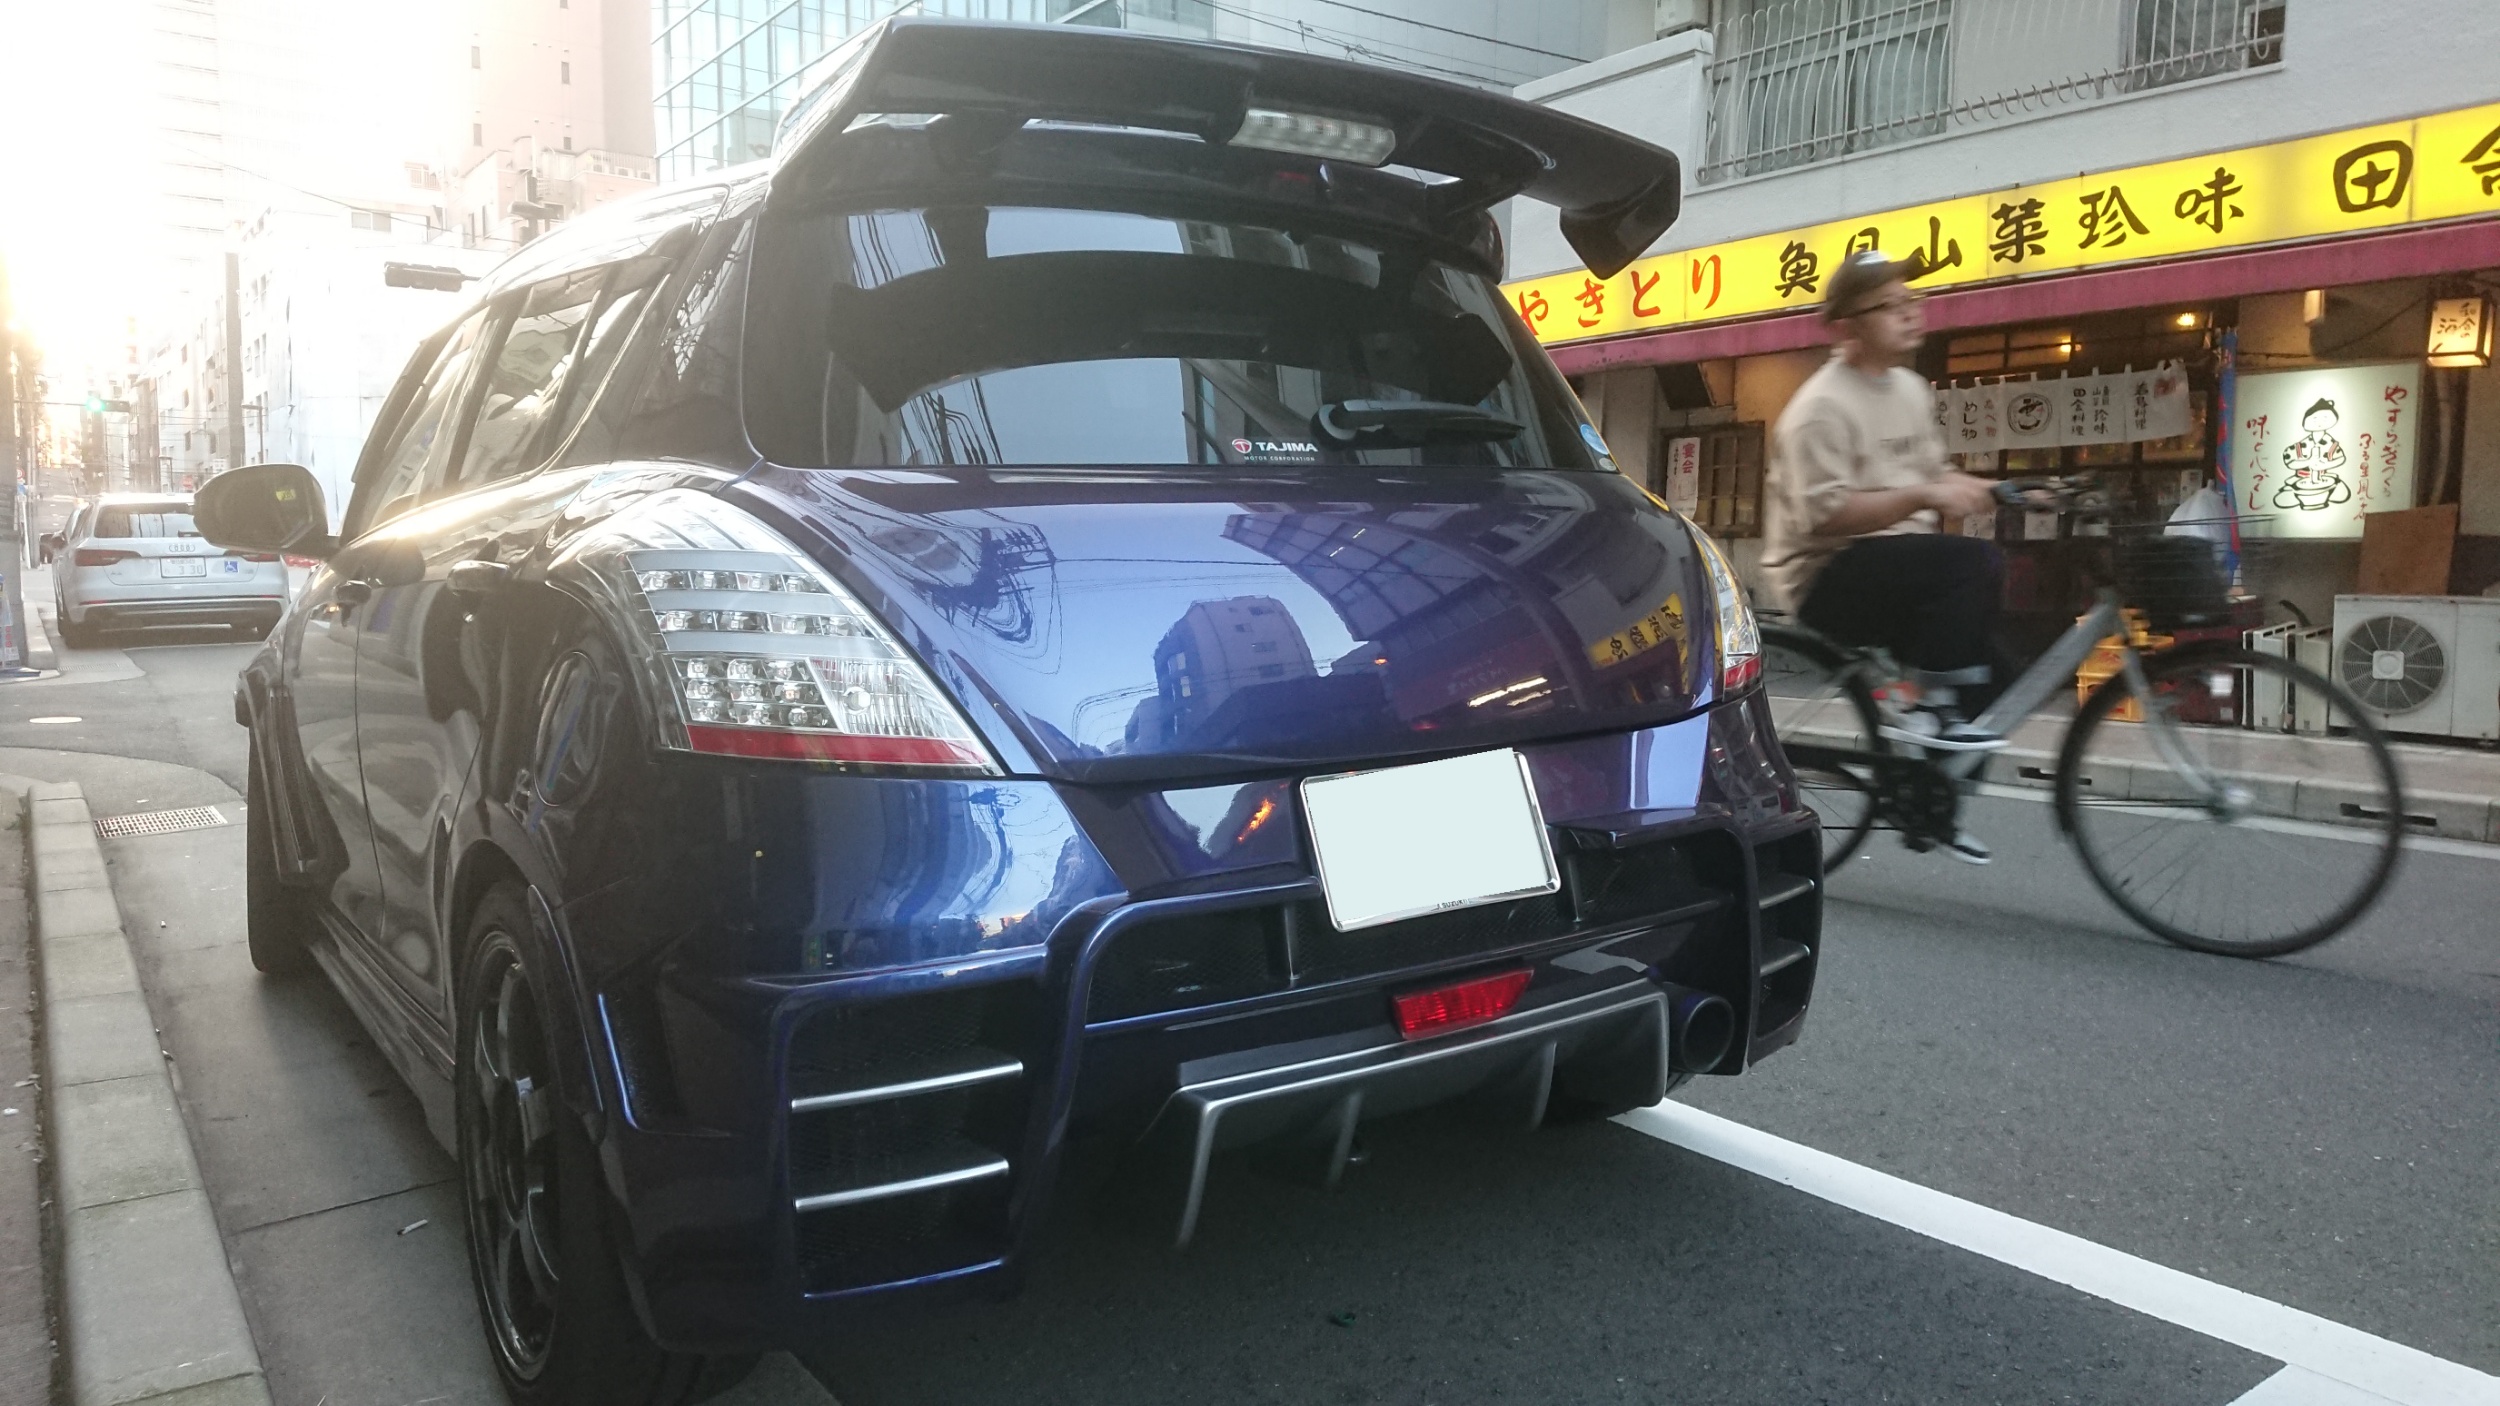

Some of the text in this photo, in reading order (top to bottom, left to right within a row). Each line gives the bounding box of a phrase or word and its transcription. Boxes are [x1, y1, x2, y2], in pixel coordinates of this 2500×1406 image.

[1518, 254, 1722, 335] やきとり
[1255, 441, 1319, 453] TAJIMA
[1682, 442, 1696, 475] 宴会
